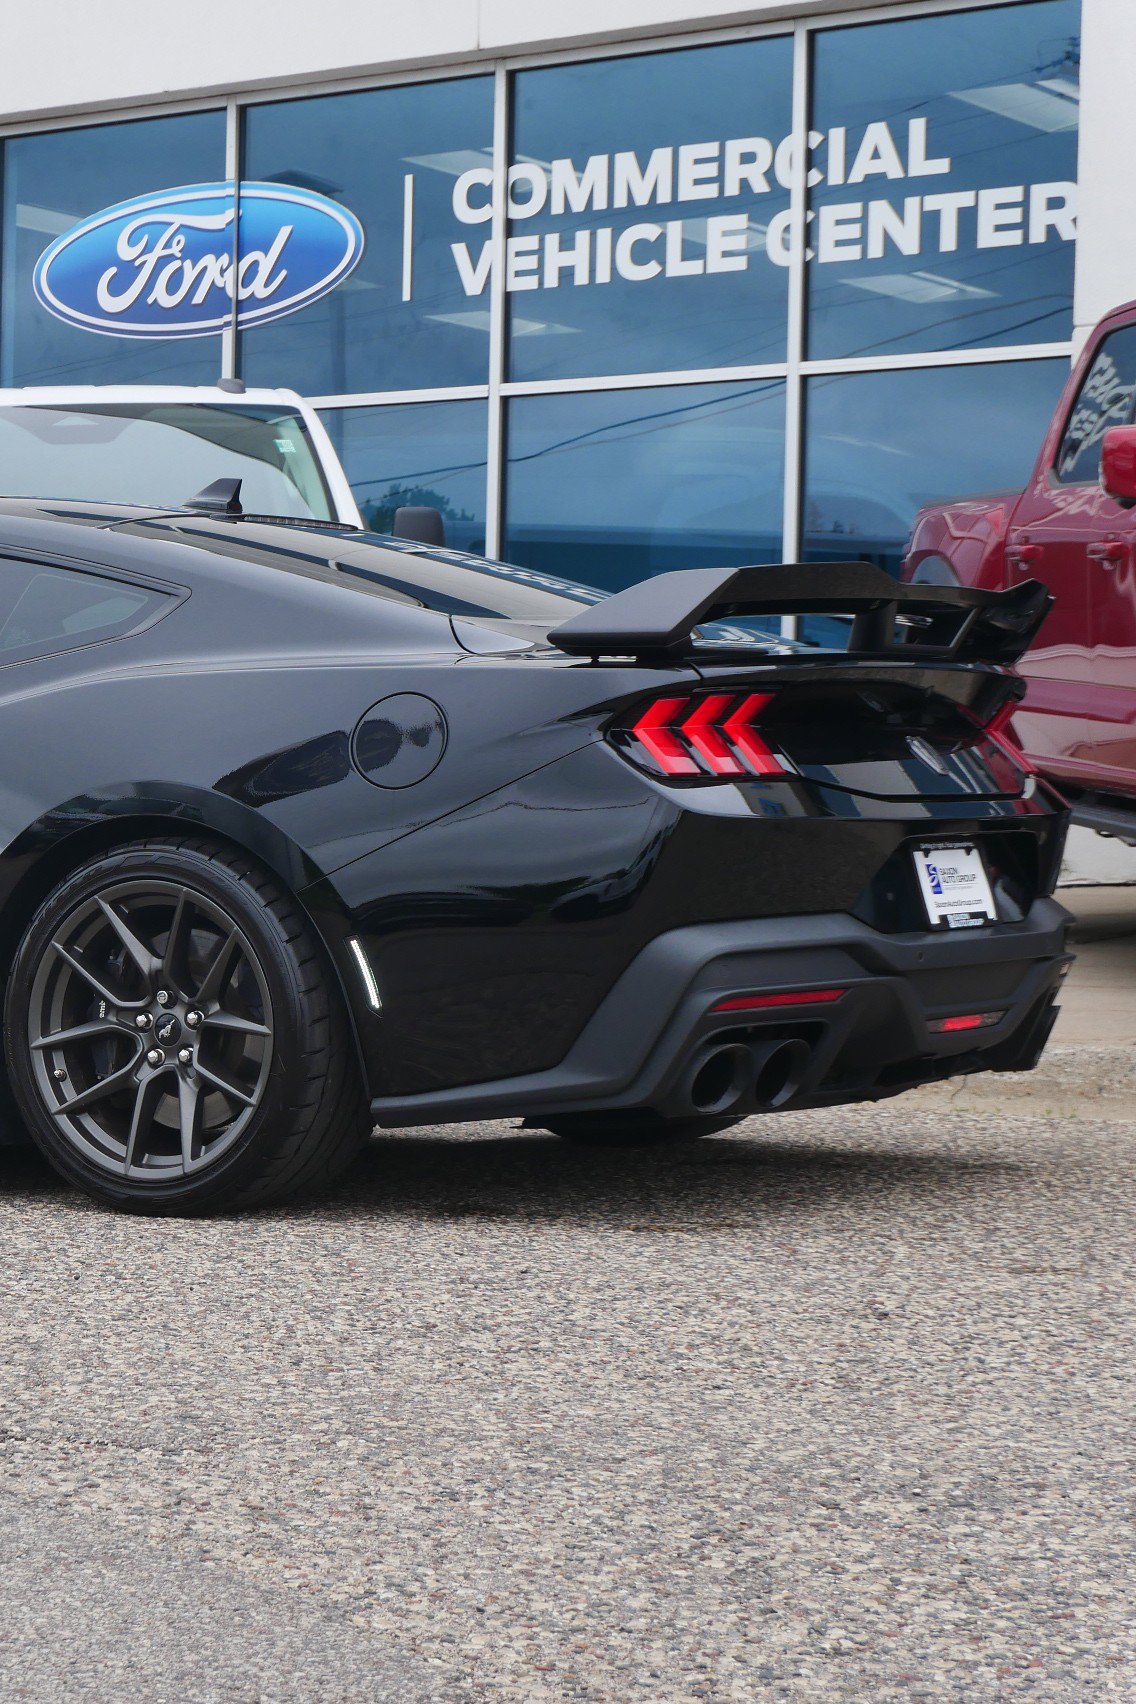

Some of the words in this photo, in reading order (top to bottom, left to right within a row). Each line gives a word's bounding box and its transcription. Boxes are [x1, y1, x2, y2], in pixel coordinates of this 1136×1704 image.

[452, 117, 951, 224] COMMERCIAL
[96, 208, 294, 313] Ford
[450, 213, 749, 296] VEHICLE
[766, 181, 1077, 267] CENTER
